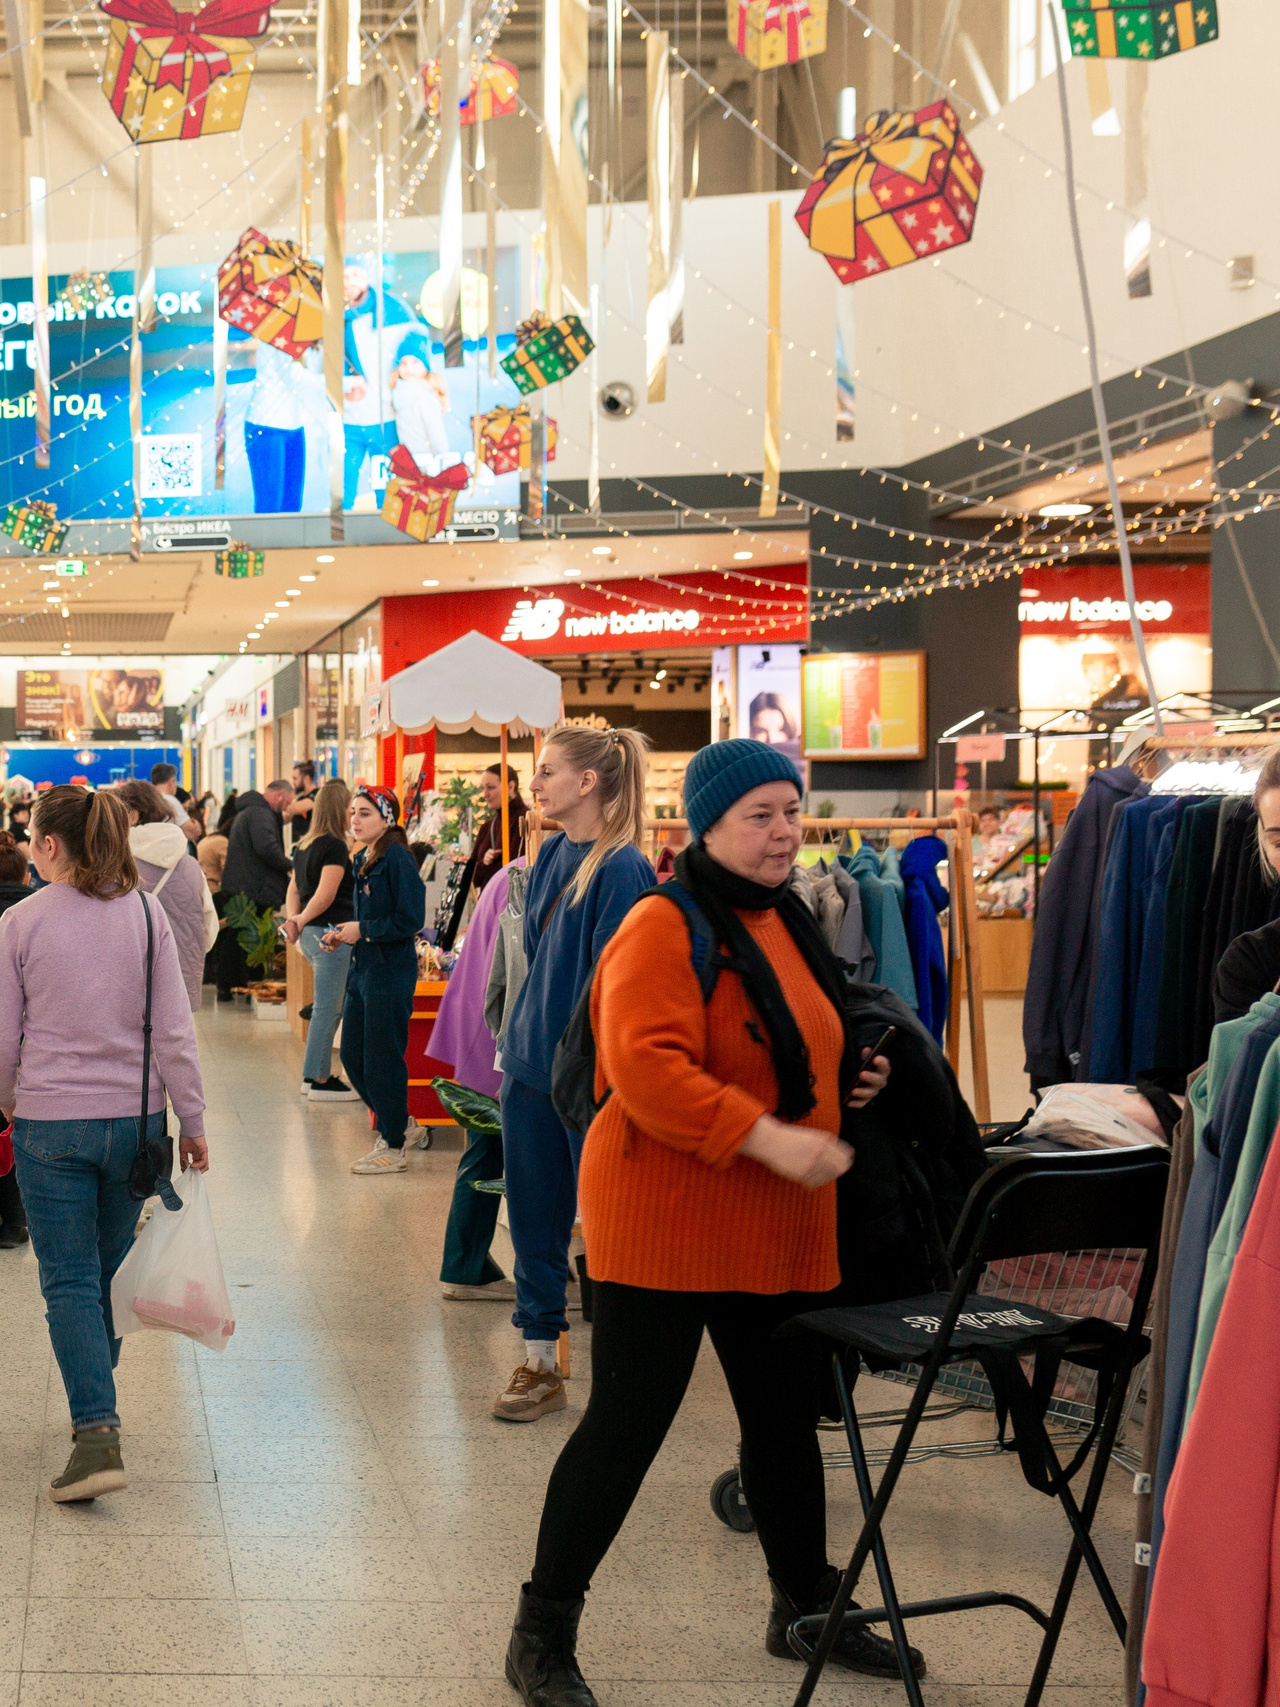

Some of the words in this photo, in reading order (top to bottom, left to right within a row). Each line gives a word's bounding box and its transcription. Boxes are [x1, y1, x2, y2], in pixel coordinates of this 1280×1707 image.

[96, 291, 203, 319] каок
[53, 393, 104, 420] год
[197, 520, 232, 533] ИКЕА
[565, 616, 609, 637] new
[610, 608, 701, 634] balance
[1018, 601, 1069, 622] new
